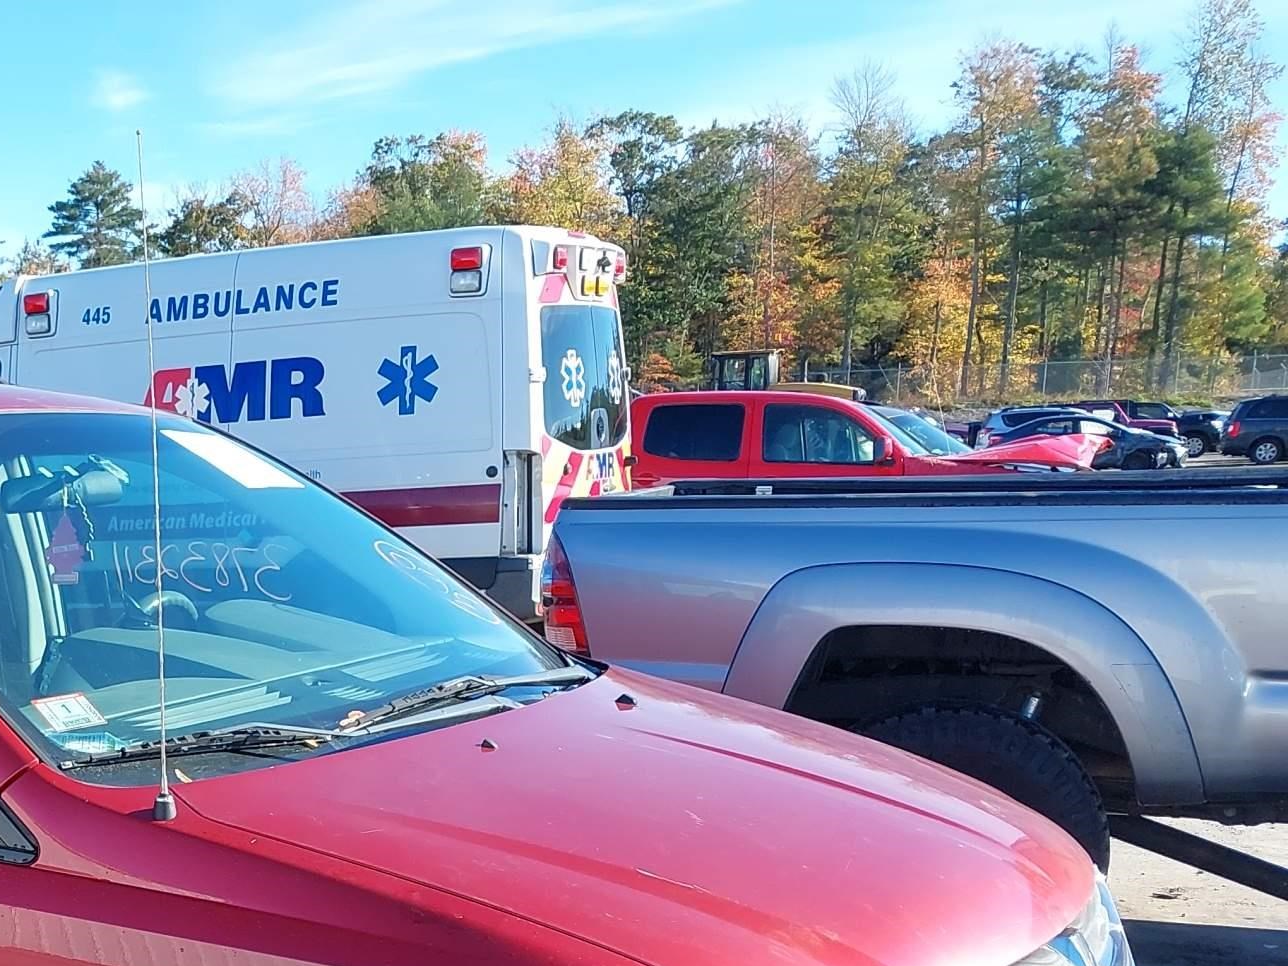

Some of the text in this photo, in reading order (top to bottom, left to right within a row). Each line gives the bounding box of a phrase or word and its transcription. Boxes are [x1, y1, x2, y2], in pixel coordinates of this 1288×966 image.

[81, 305, 112, 326] 445
[145, 279, 340, 325] AMBULANCE
[143, 356, 326, 424] AMR
[107, 515, 186, 533] American
